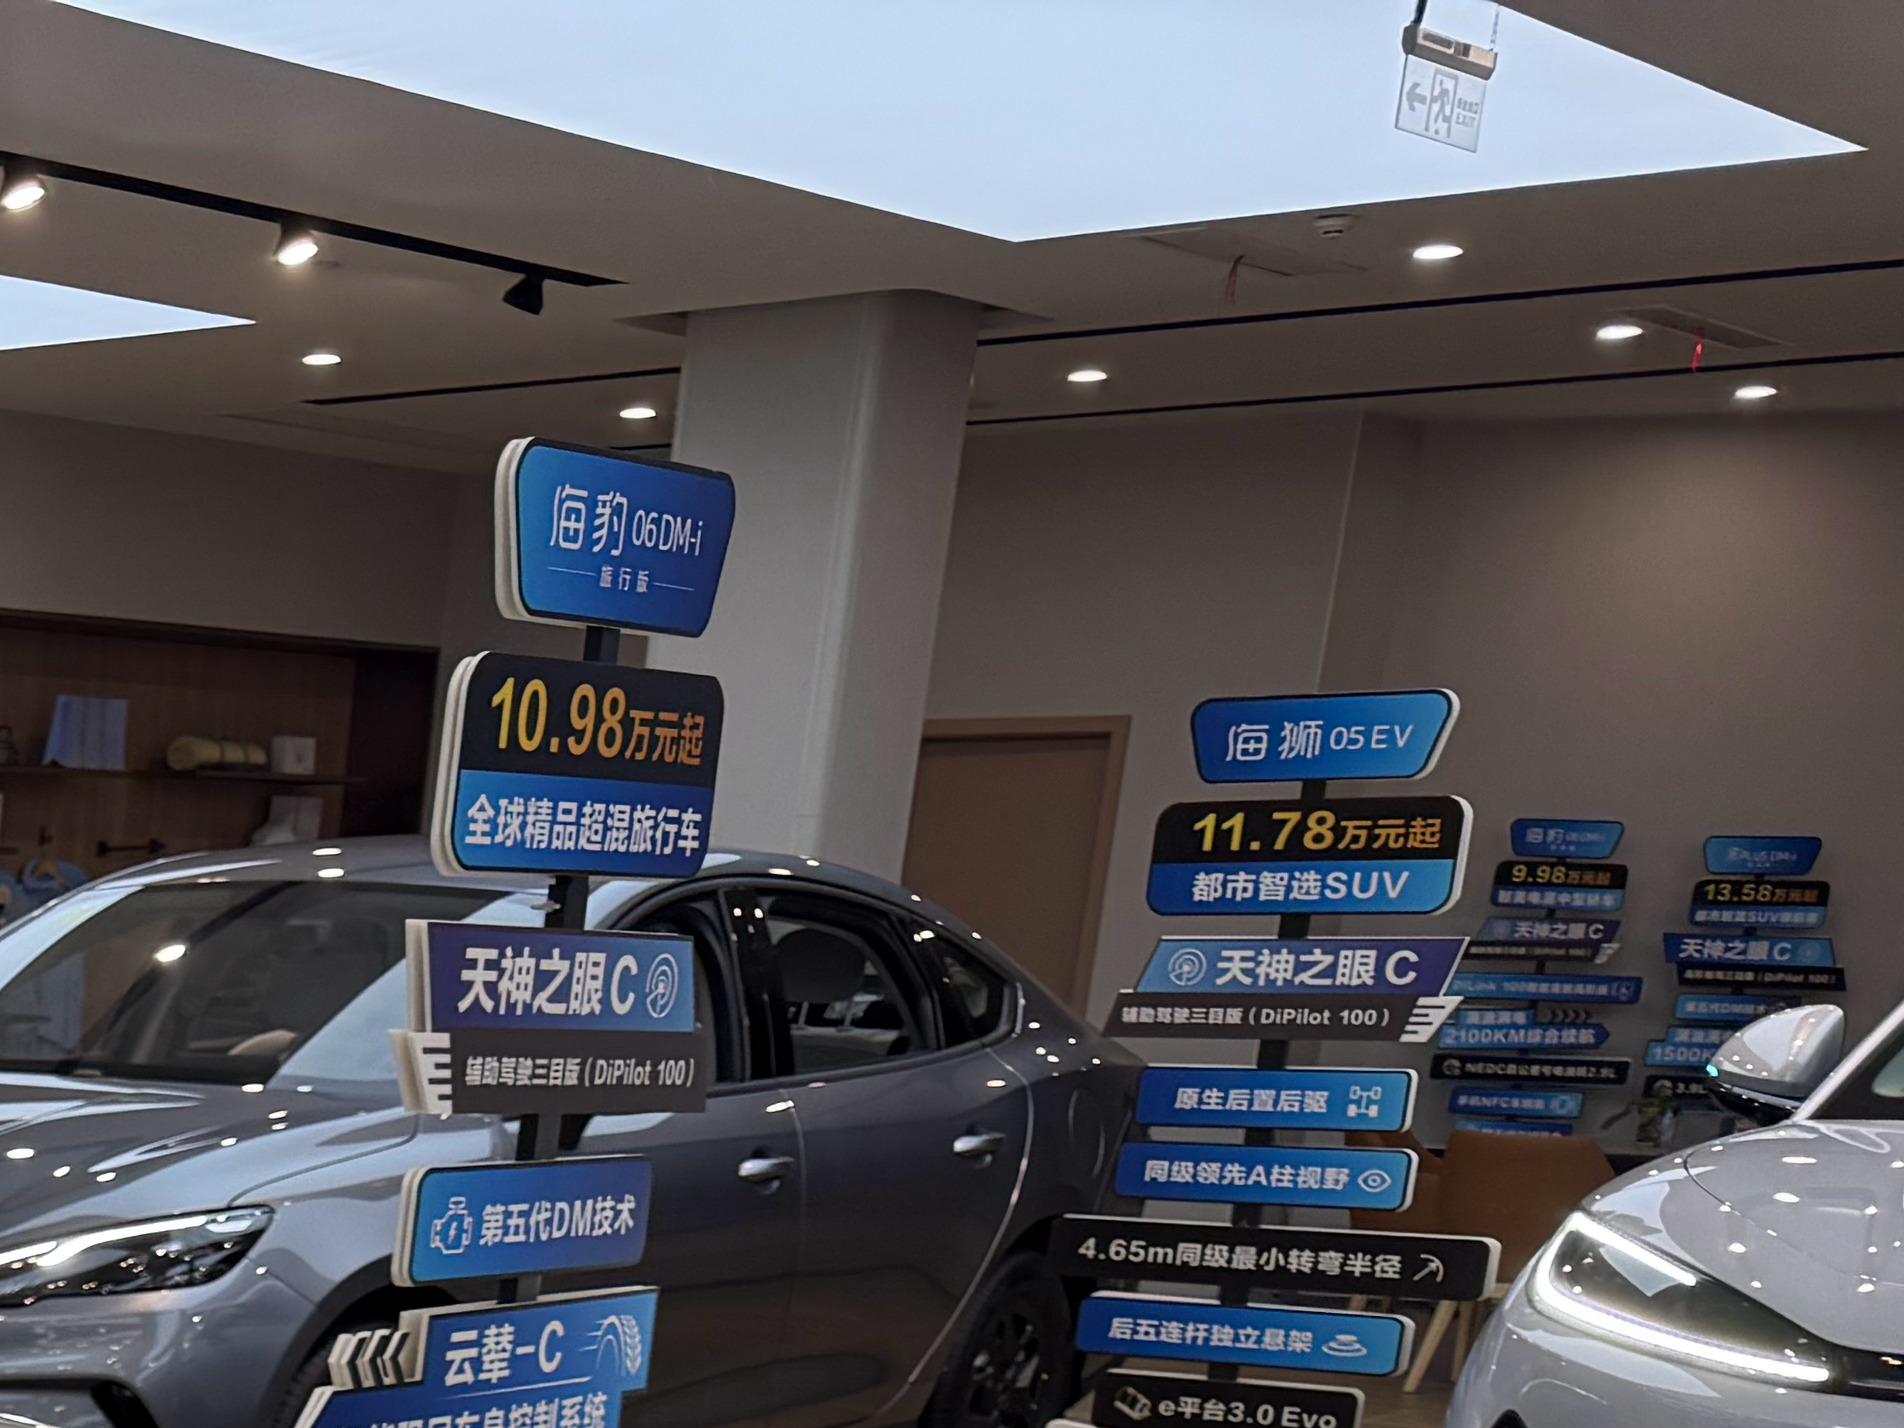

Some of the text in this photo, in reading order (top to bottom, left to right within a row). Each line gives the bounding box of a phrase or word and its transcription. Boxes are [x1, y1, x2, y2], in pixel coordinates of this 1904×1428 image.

[599, 565, 650, 594] 旅行版
[490, 676, 706, 767] 10.98万元起
[464, 793, 704, 857] 全球精品超混旅行车
[1191, 809, 1443, 853] 11.78万元起
[1191, 870, 1411, 903] 都市智选SUV
[1173, 1087, 1330, 1114] 原生后置后驱
[1143, 1158, 1351, 1191] 同级领先A柱视野
[479, 1194, 636, 1249] 第五代DM技术
[1077, 1236, 1403, 1281] 4.65m同级最小转弯半径
[443, 1319, 566, 1387] 云辇-C
[1108, 1316, 1314, 1353] 后五连杆独立悬架
